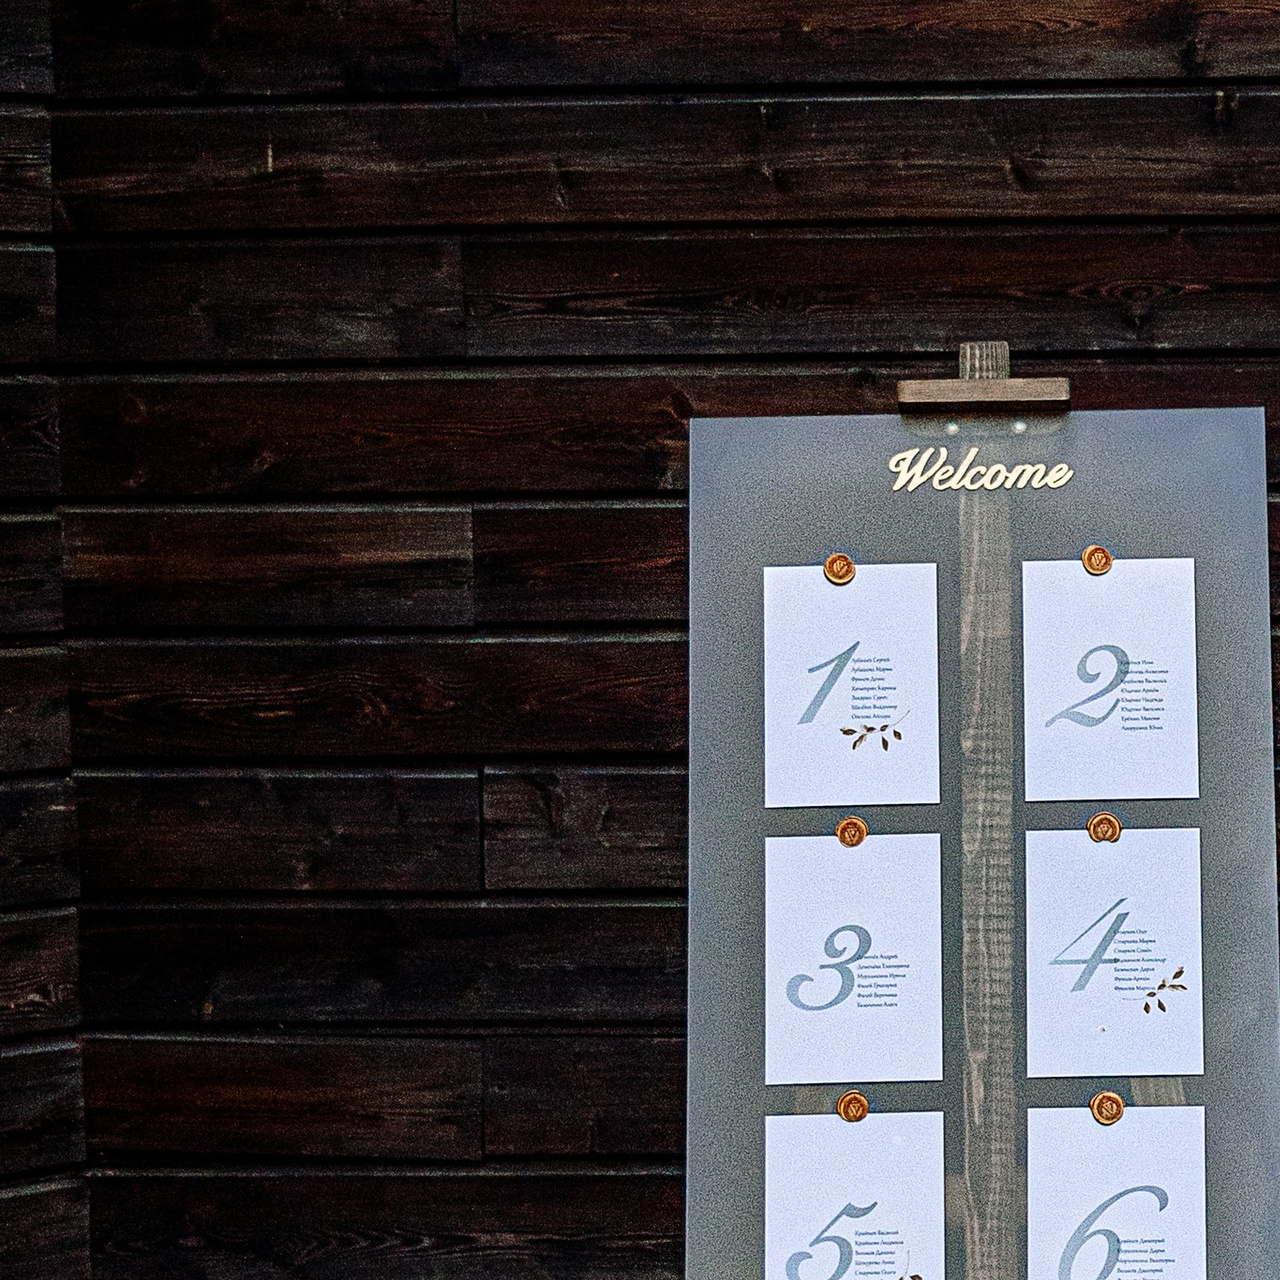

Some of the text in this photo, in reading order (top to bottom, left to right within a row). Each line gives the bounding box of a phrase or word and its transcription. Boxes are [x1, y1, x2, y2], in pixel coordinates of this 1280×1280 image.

[888, 446, 1075, 493] Welcome
[798, 641, 859, 725] 1
[1045, 645, 1130, 727] 2
[786, 924, 872, 1012] 3
[1050, 896, 1130, 992] 4
